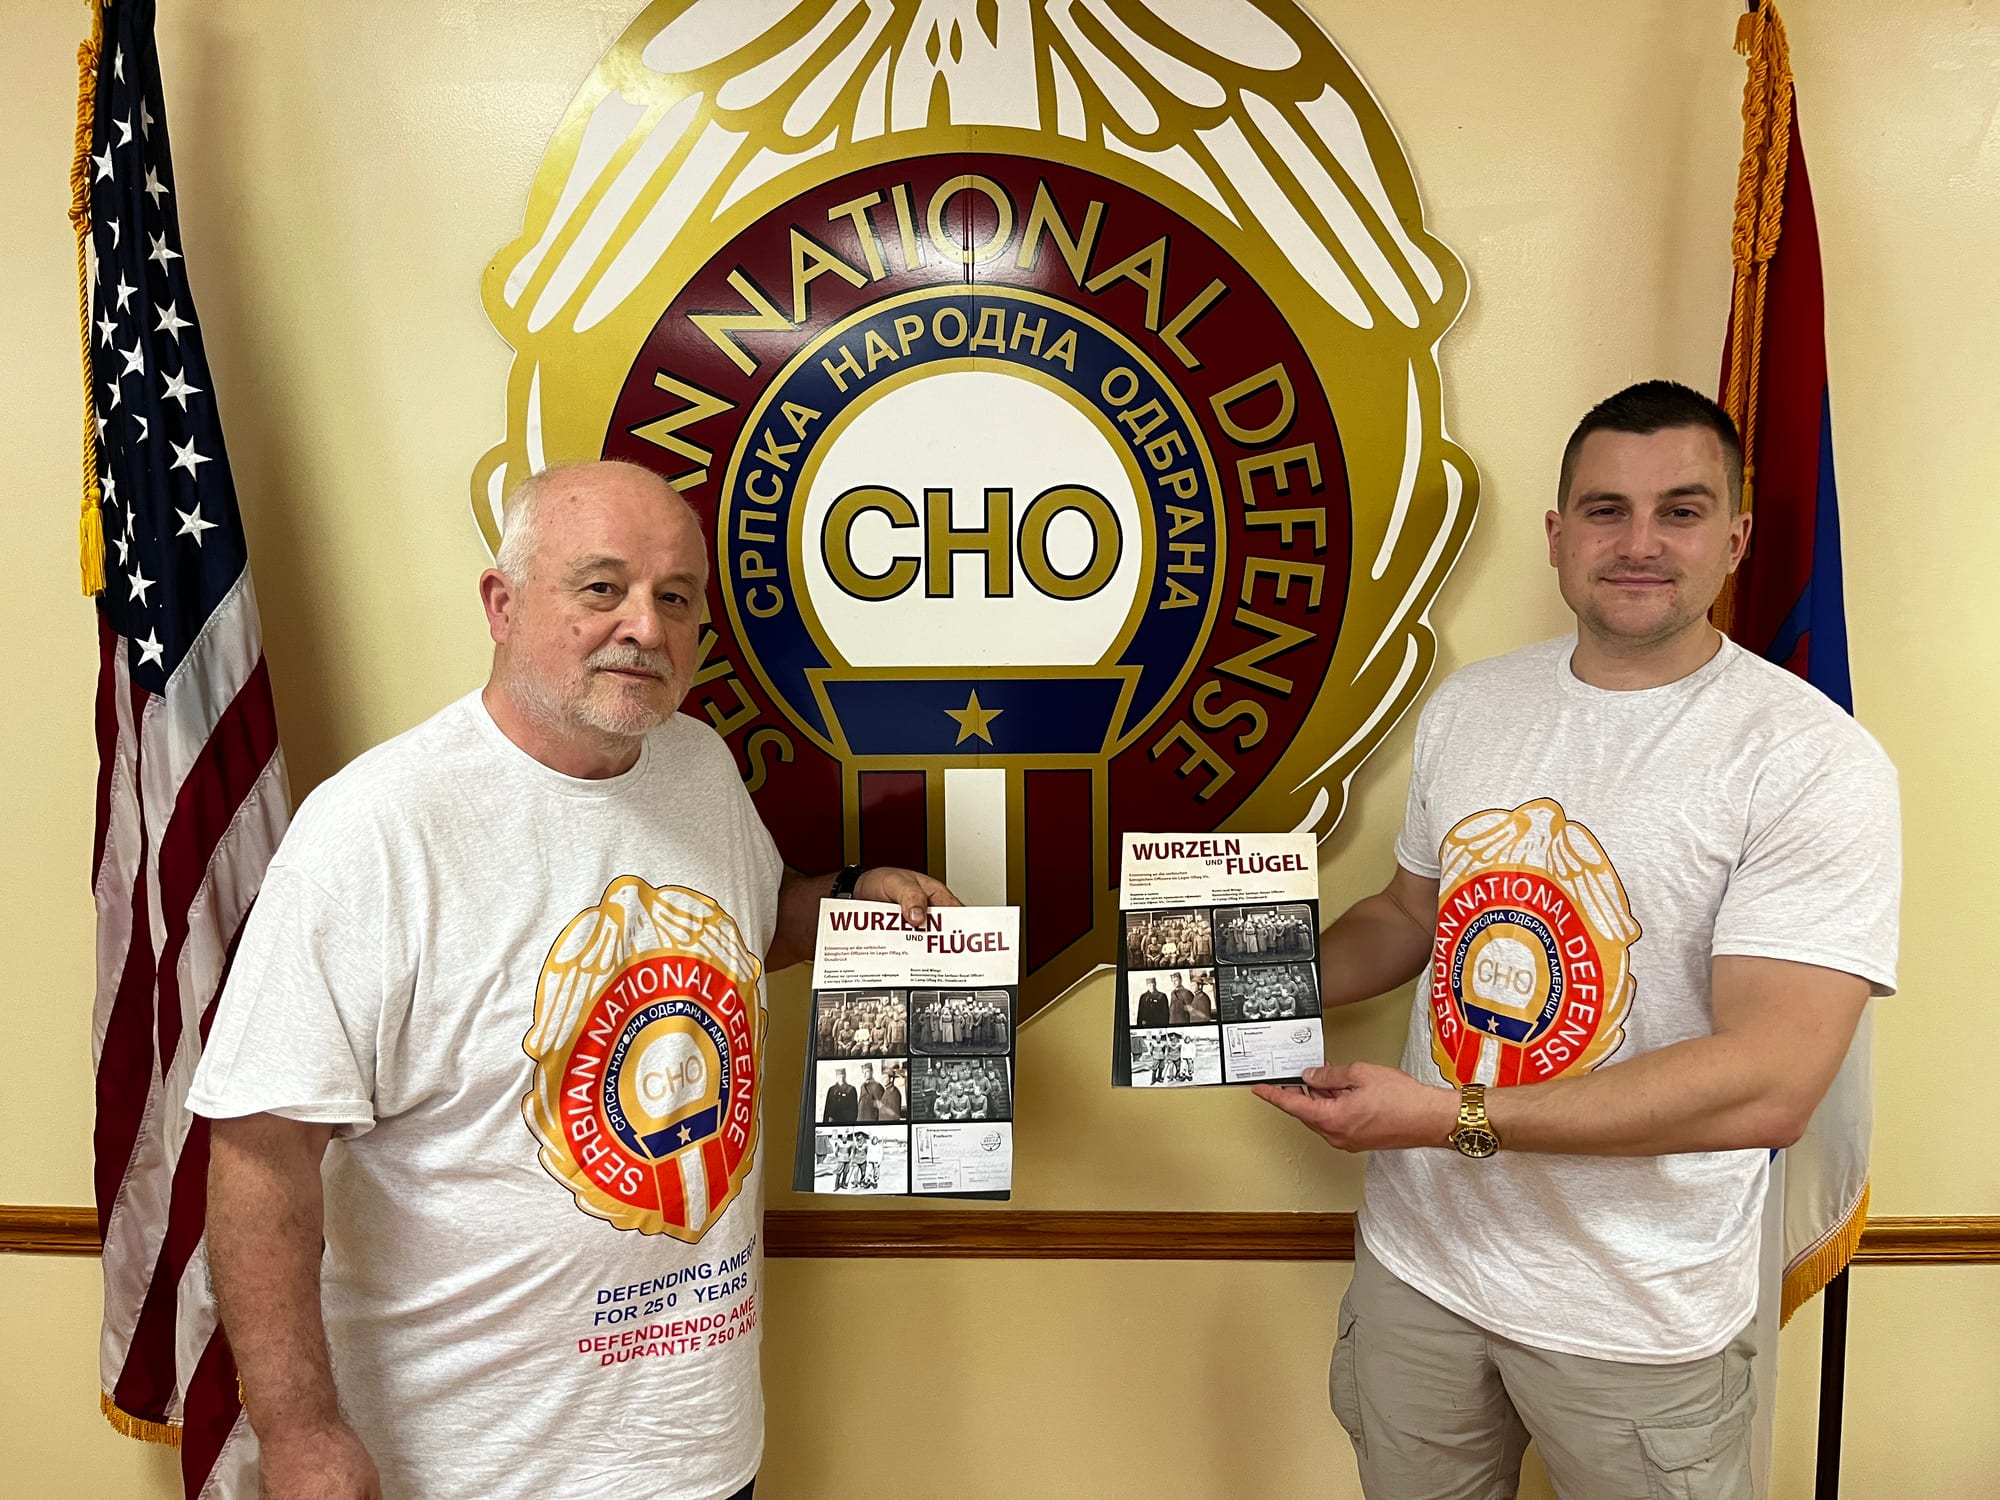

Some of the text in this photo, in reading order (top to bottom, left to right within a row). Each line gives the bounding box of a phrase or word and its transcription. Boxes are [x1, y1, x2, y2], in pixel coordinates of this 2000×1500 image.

[686, 173, 1228, 372] NATIONAL
[1150, 362, 1329, 801] DEFENSE
[738, 307, 1206, 618] СРПСКА НАРОДНА ОДБРАНА
[1132, 839, 1240, 860] WURZELN
[1226, 852, 1308, 875] FLÜGEL
[905, 930, 1009, 953] UND FLÜGEL
[1452, 943, 1468, 988] СРПСКА
[1508, 911, 1552, 947] ОДБРАНА
[1543, 958, 1562, 1019] АМЕРИЦИ
[1453, 876, 1572, 937] NATIONAL
[1530, 935, 1597, 1075] DEFENSE
[649, 1002, 702, 1020] ОДБРАНА
[610, 1014, 648, 1071] НАРОДНА
[709, 1025, 729, 1089] АМЕРИЦИ
[567, 963, 753, 1196] SERBIAN NATIONAL DEFENSE
[605, 1075, 626, 1131] СРПСКА
[597, 1233, 757, 1305] DEFENDING AMER
[594, 1272, 747, 1326] FOR 250 YEARS
[578, 1313, 726, 1354] DEFENDIENDO
[601, 1336, 701, 1367] DURANTE
[707, 1326, 734, 1347] 250
